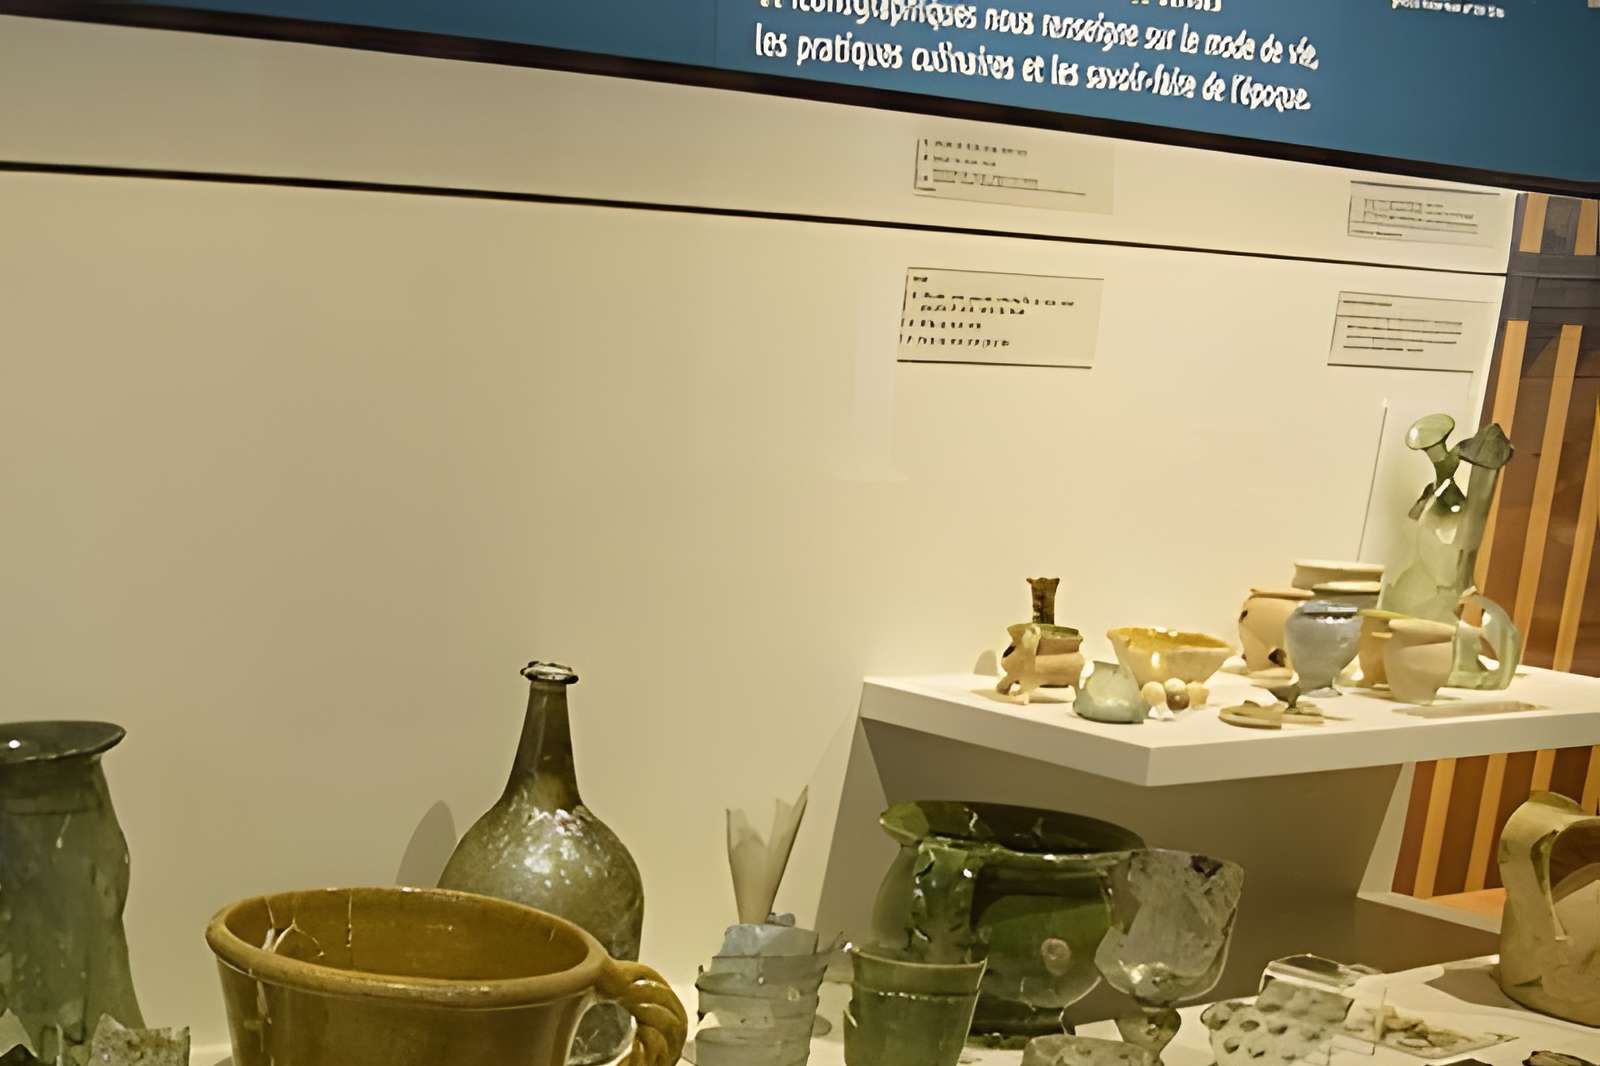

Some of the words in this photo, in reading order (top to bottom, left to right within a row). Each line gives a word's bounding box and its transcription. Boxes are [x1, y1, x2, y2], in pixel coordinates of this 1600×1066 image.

[755, 22, 788, 57] les
[796, 31, 903, 71] pratiques
[1022, 55, 1045, 83] et
[1051, 54, 1079, 86] les
[1201, 71, 1227, 101] de
[984, 8, 1034, 35] nous
[1179, 22, 1200, 54] le
[1259, 33, 1284, 63] de
